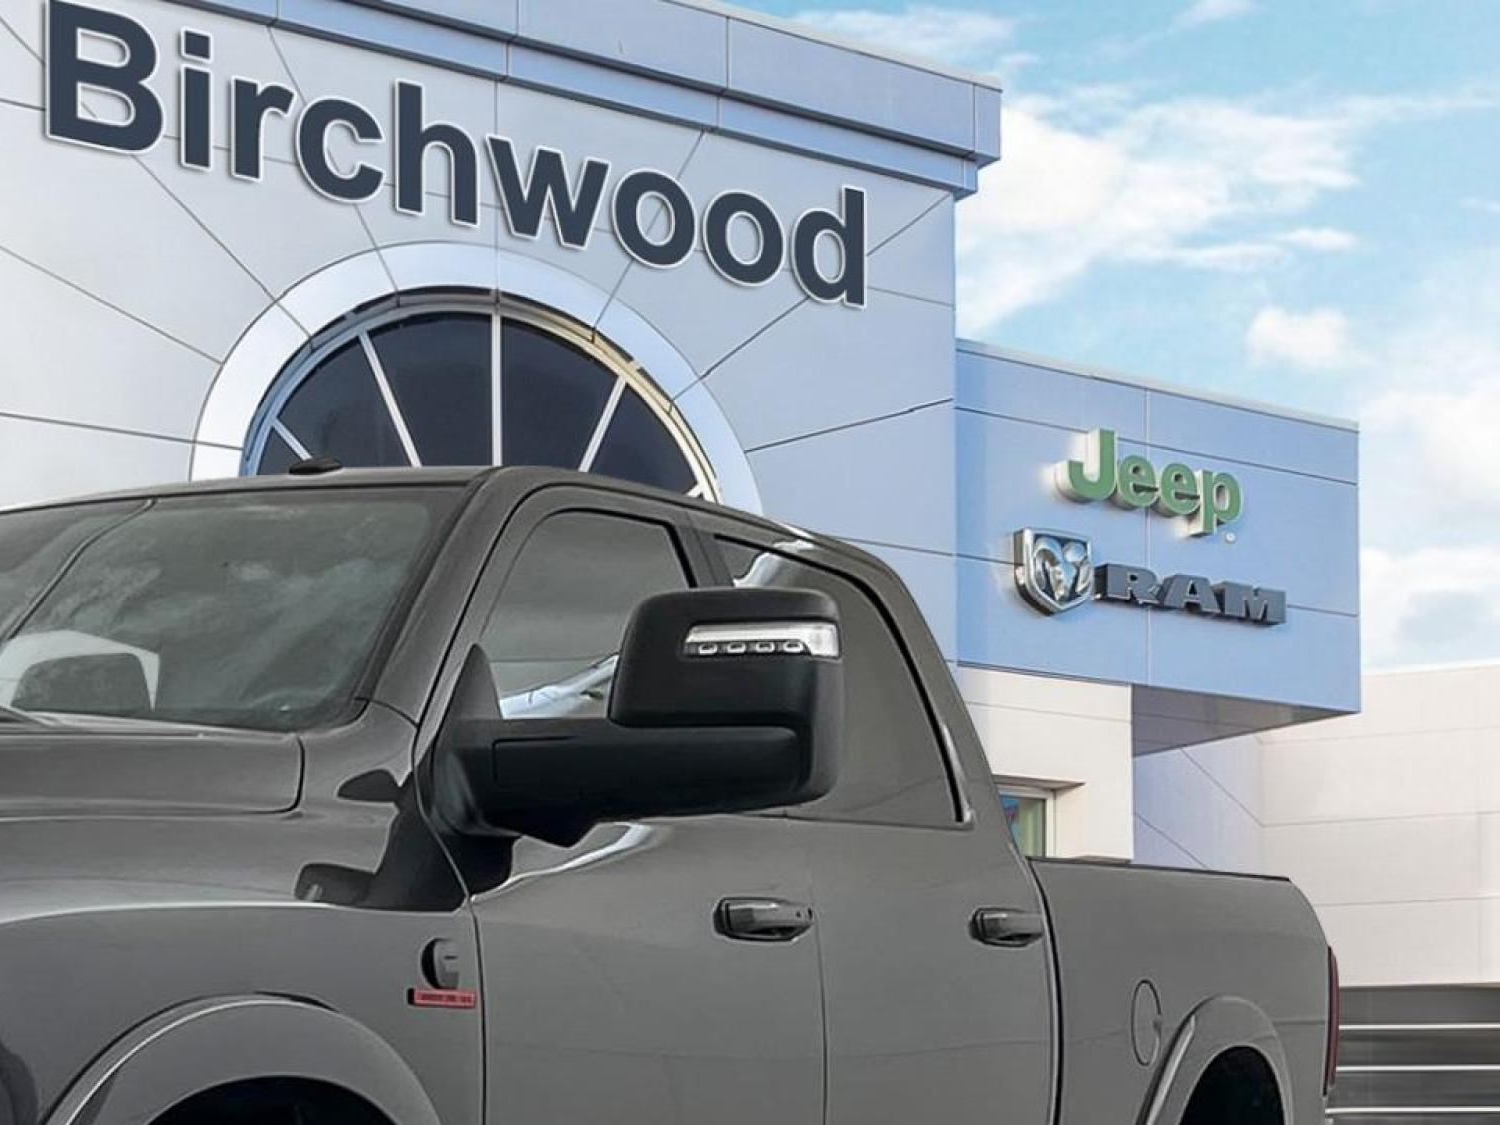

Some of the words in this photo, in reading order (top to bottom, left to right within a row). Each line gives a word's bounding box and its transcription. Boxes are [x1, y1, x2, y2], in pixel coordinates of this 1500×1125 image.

[46, 0, 867, 308] Birchwood
[1056, 427, 1243, 537] Jeep
[1094, 563, 1287, 625] RAM
